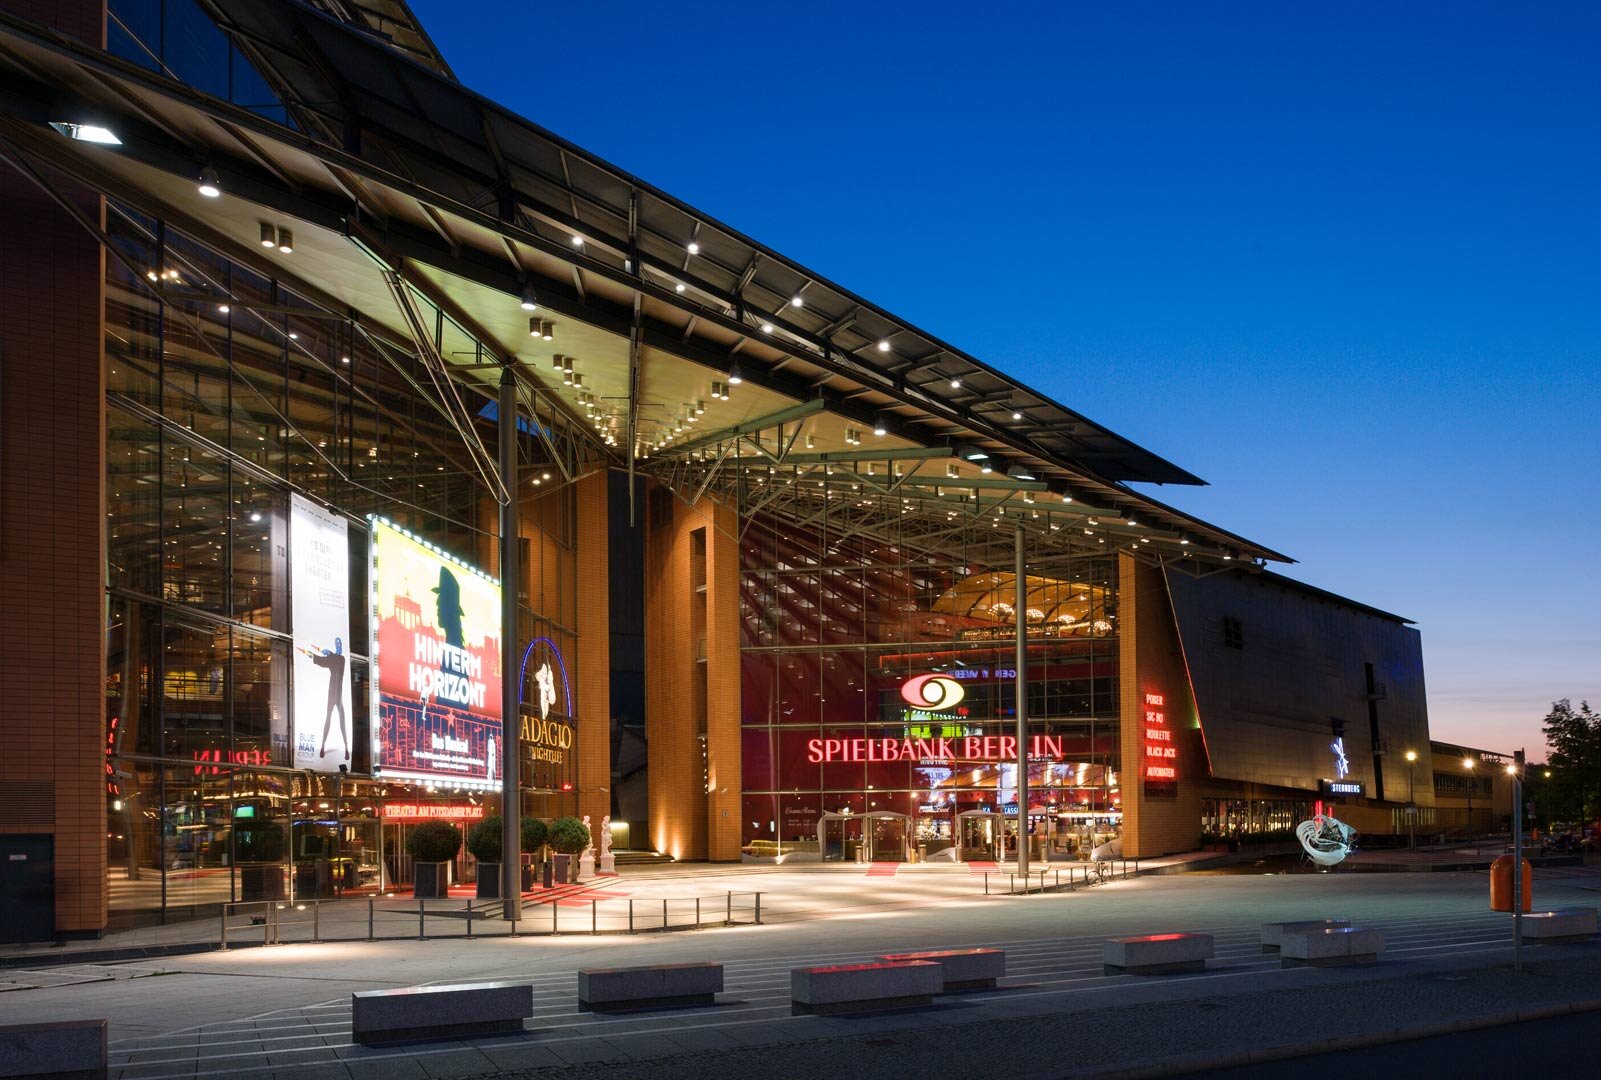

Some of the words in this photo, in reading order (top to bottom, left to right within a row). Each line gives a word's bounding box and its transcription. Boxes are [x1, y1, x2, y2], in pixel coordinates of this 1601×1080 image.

[415, 632, 481, 680] HINTERM
[409, 662, 486, 708] HORIZONT
[1146, 694, 1163, 706] POKER
[1146, 711, 1155, 722] SIC
[1156, 712, 1164, 723] BO
[299, 733, 316, 743] BLUE
[520, 715, 572, 749] ADAGIO
[1146, 728, 1171, 741] ROULETTE
[298, 742, 315, 752] MAN
[807, 737, 956, 763] SPIELBANK
[965, 735, 1062, 760] BERIN
[1146, 746, 1163, 757] BLACK
[1163, 748, 1176, 758] JACK
[529, 746, 563, 763] NIGHTLIFE
[1146, 767, 1175, 778] AUTOMATEN
[1332, 783, 1360, 793] STERNBERG
[386, 805, 417, 817] THEATER
[418, 806, 429, 817] AM
[430, 806, 464, 818] POTSDAMER
[465, 807, 483, 818] PLATZ
